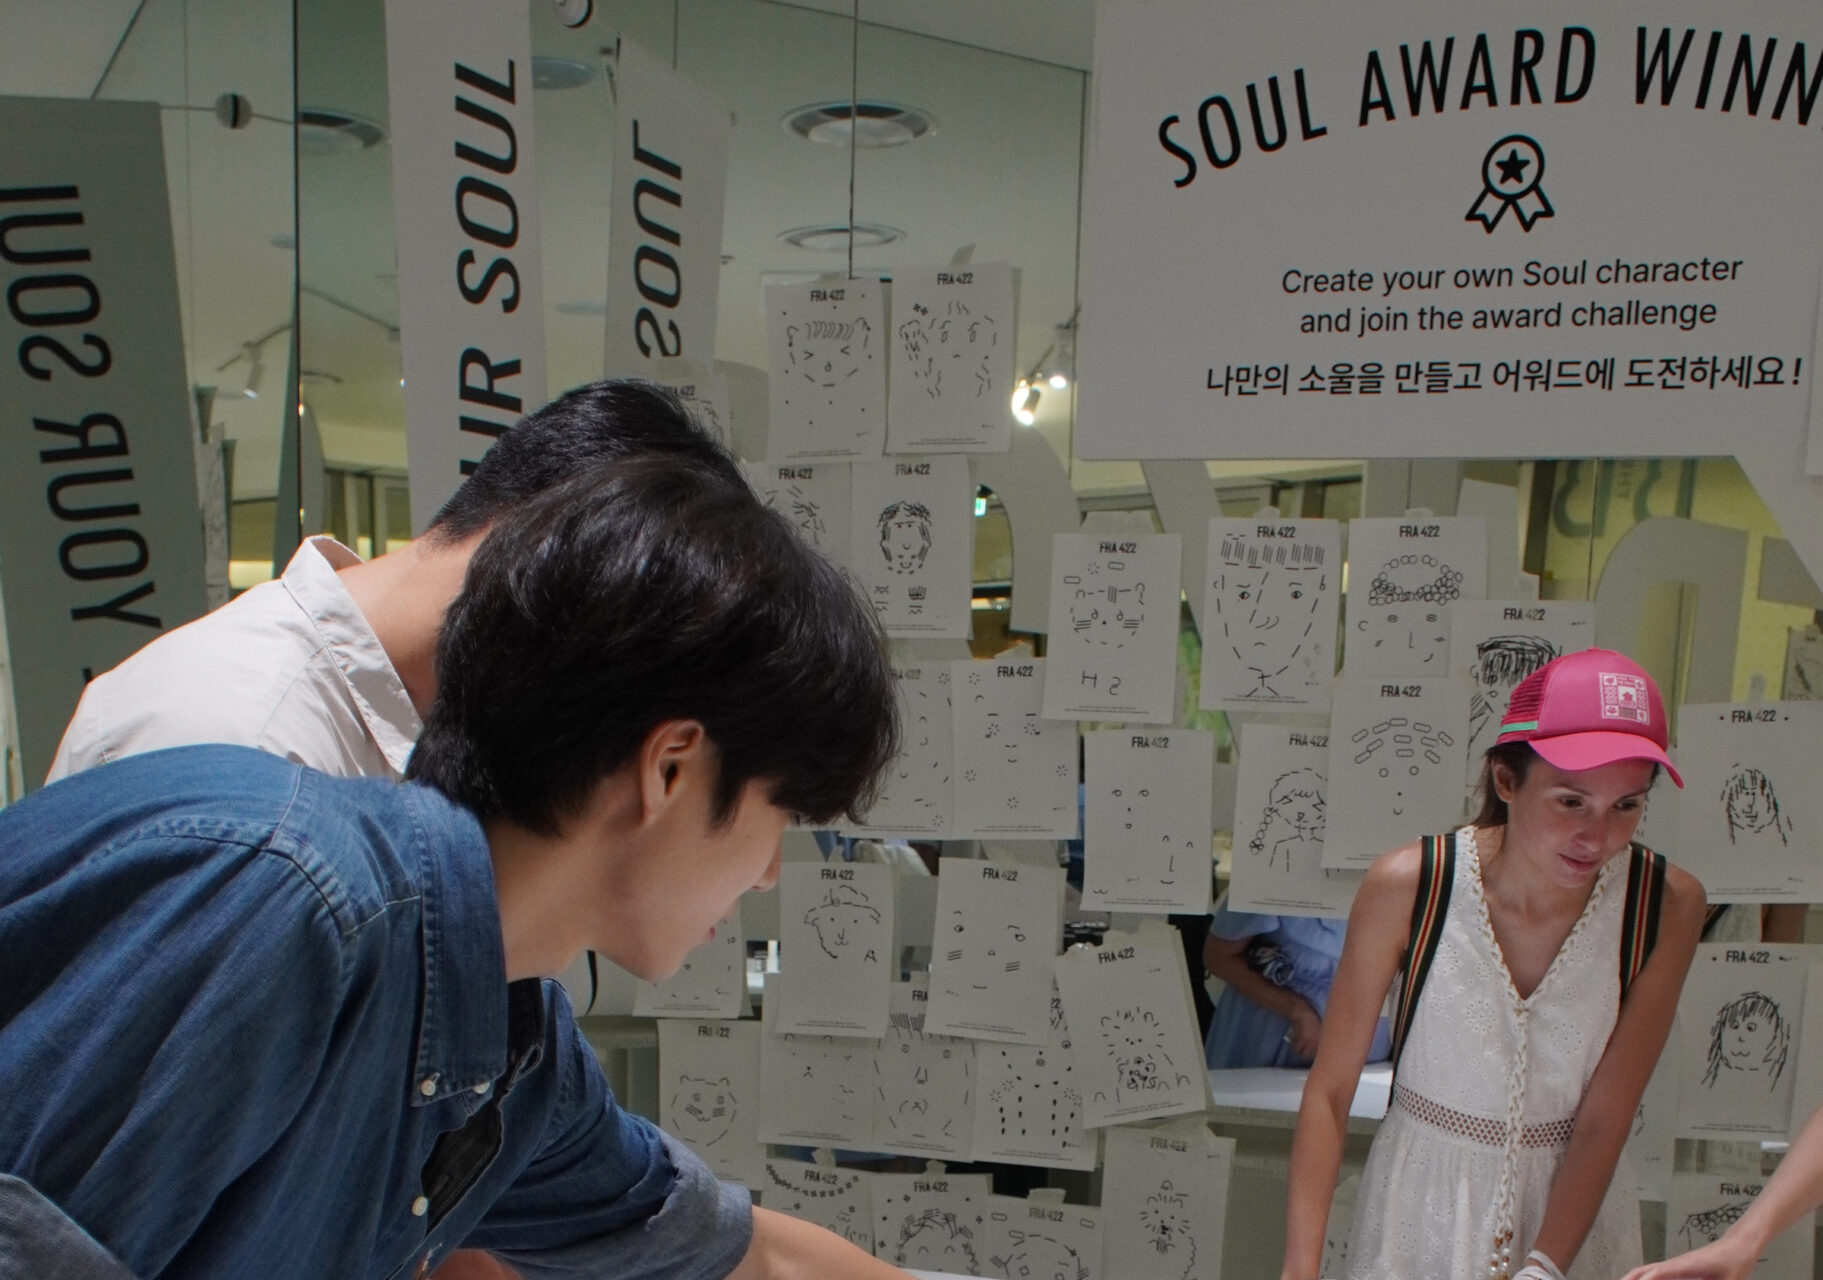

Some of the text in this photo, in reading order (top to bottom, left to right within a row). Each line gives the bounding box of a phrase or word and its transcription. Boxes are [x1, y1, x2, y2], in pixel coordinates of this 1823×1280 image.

[1158, 67, 1328, 188] SOUL
[1358, 26, 1597, 127] AWARD
[454, 59, 521, 314] SOUL
[937, 272, 973, 285] FRA 422
[1282, 257, 1744, 297] Create your own Soul character
[811, 289, 845, 302] FRA 422
[1300, 299, 1717, 339] and join the award challenge
[1207, 355, 1803, 397] 나만의 소울을 만들고 어워드에 도전하세요!
[778, 467, 813, 480] FRA 422
[914, 463, 931, 475] 422
[1257, 526, 1296, 539] FRA 422
[1399, 525, 1440, 538] FRA 422
[1100, 542, 1137, 554] FRA 422
[1503, 608, 1522, 621] FRA
[997, 665, 1034, 679] FRA 422
[1380, 684, 1422, 698] FRA 422
[1732, 710, 1776, 723] FRA 422
[1132, 736, 1150, 748] FRA
[1289, 734, 1328, 748] FRA 422
[821, 869, 854, 881] FRA 422
[983, 867, 999, 880] FRA
[1098, 946, 1135, 965] FRA 422
[1726, 950, 1770, 965] FRA 422
[804, 1170, 819, 1183] FRA
[914, 1181, 949, 1193] FRA 422
[1720, 1183, 1740, 1196] FRA
